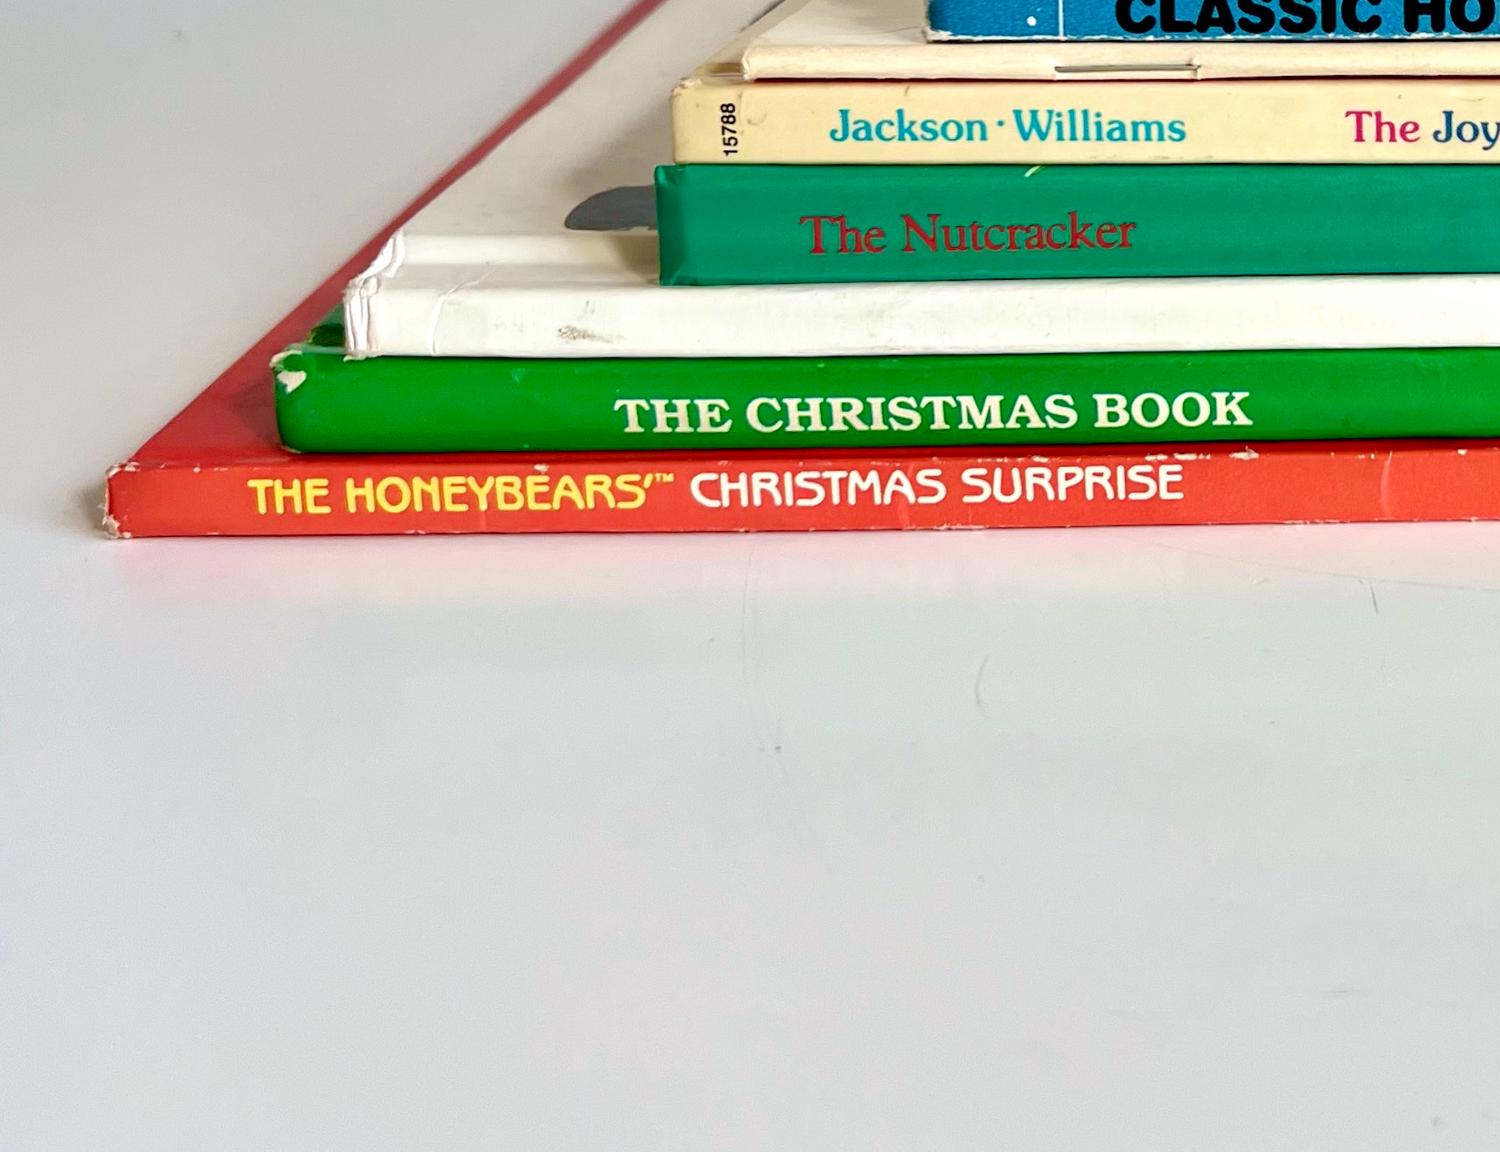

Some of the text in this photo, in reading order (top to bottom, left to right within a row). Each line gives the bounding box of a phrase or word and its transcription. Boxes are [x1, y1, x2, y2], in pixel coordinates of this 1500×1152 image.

[722, 102, 738, 157] 15788
[830, 108, 1186, 143] Jackson Williams
[1345, 110, 1421, 144] The
[800, 211, 1136, 255] The Nutcracker
[614, 392, 1253, 435] THE CHRISTMAS BOOK
[247, 478, 332, 515] THE
[690, 467, 947, 508] CHRISTMAS
[961, 464, 1184, 504] SURPRISE
